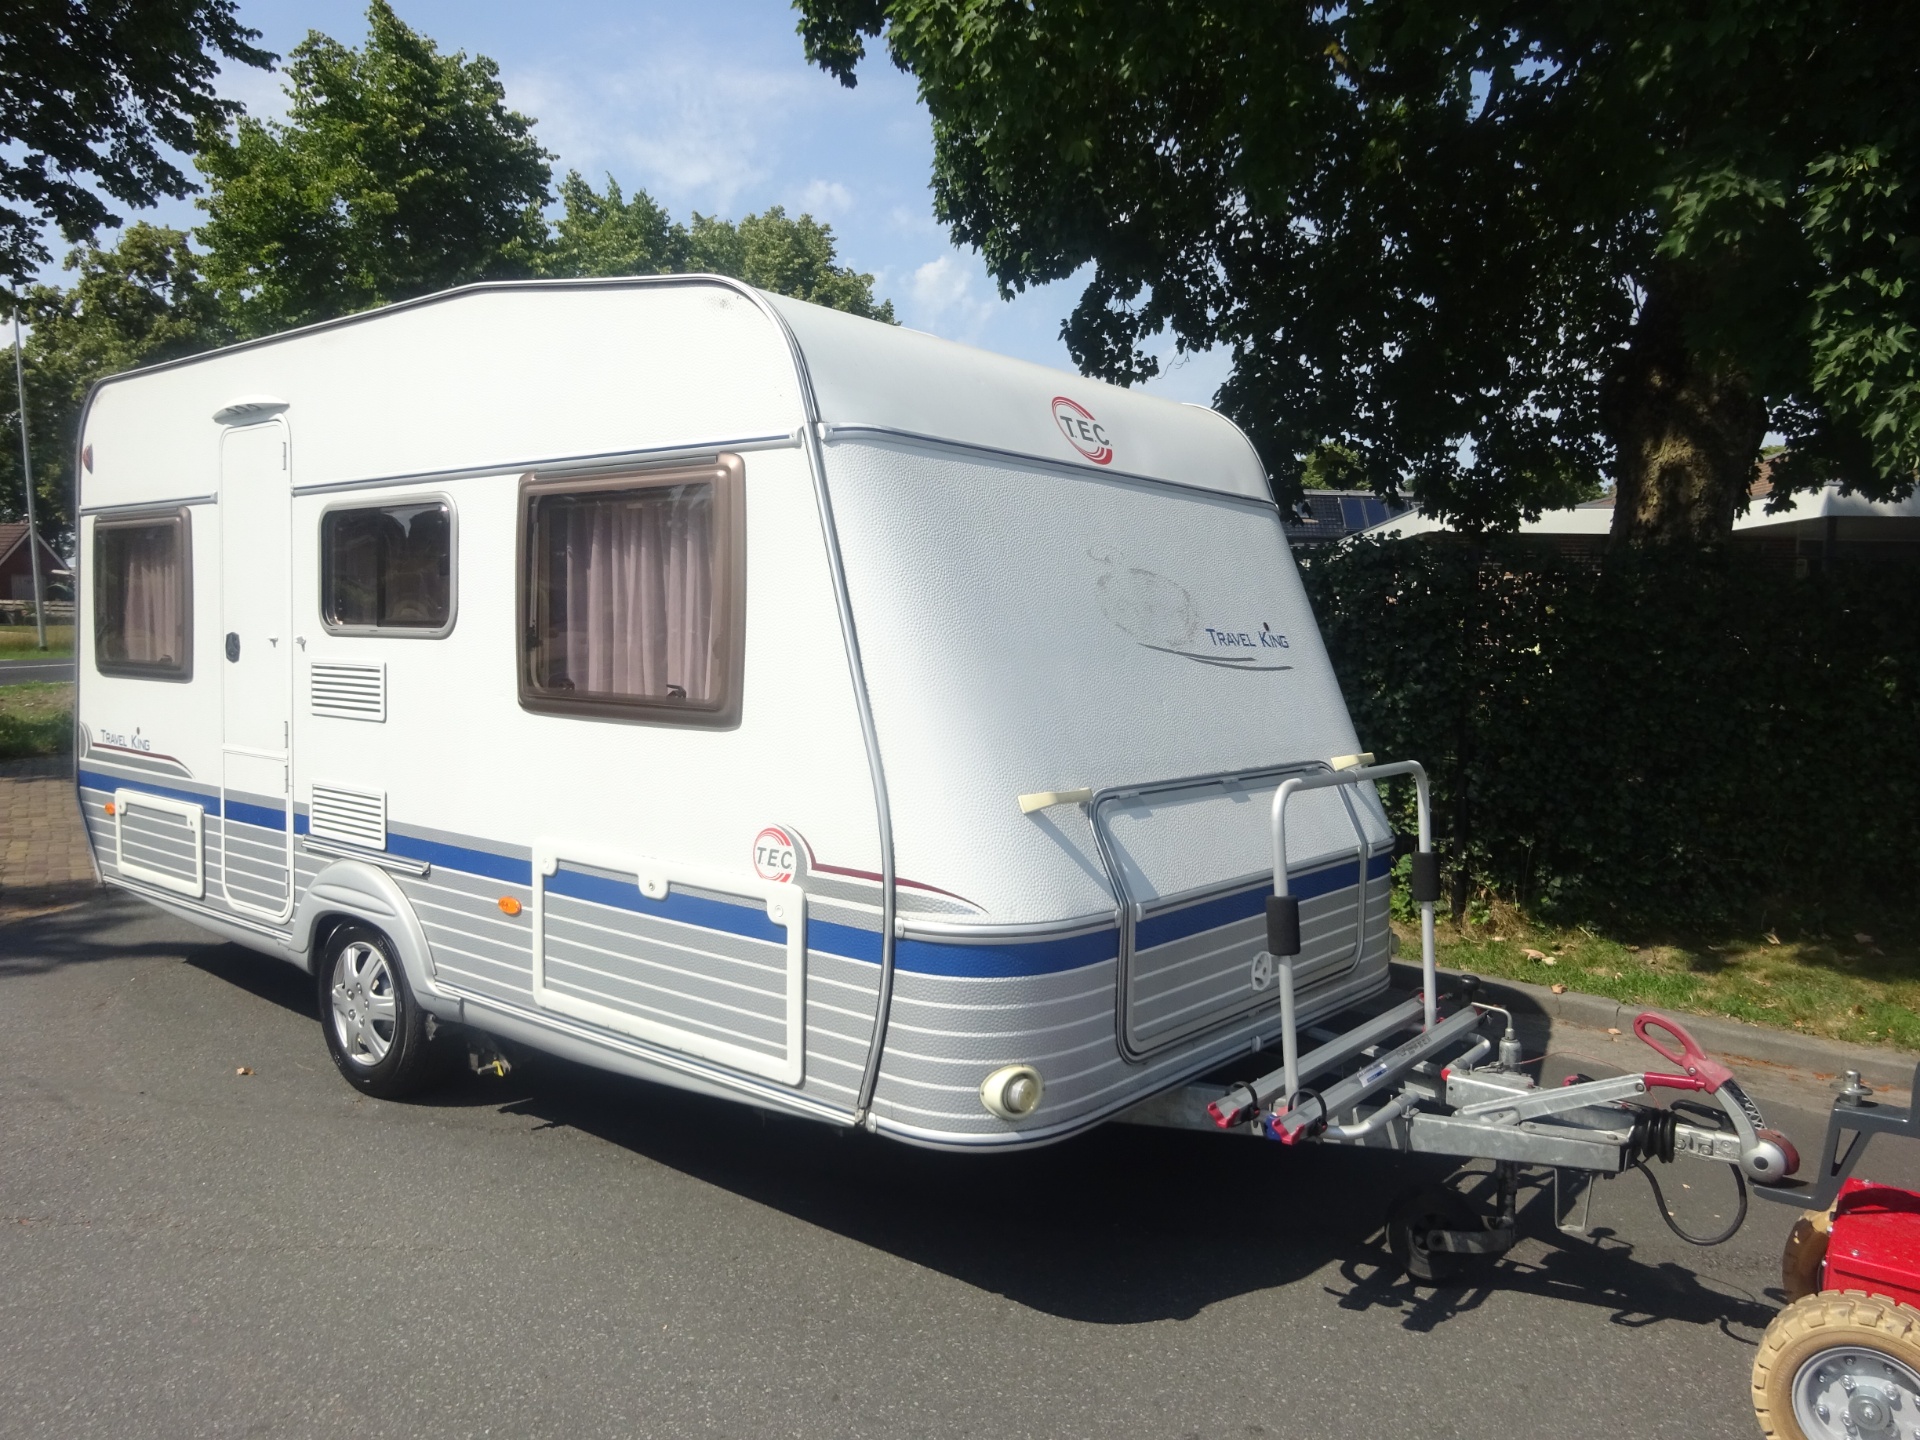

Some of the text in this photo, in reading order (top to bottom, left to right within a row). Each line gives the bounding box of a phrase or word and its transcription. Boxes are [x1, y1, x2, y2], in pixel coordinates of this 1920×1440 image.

[1205, 628, 1290, 649] TRAVEL KING
[100, 729, 151, 751] TRAVEL KING
